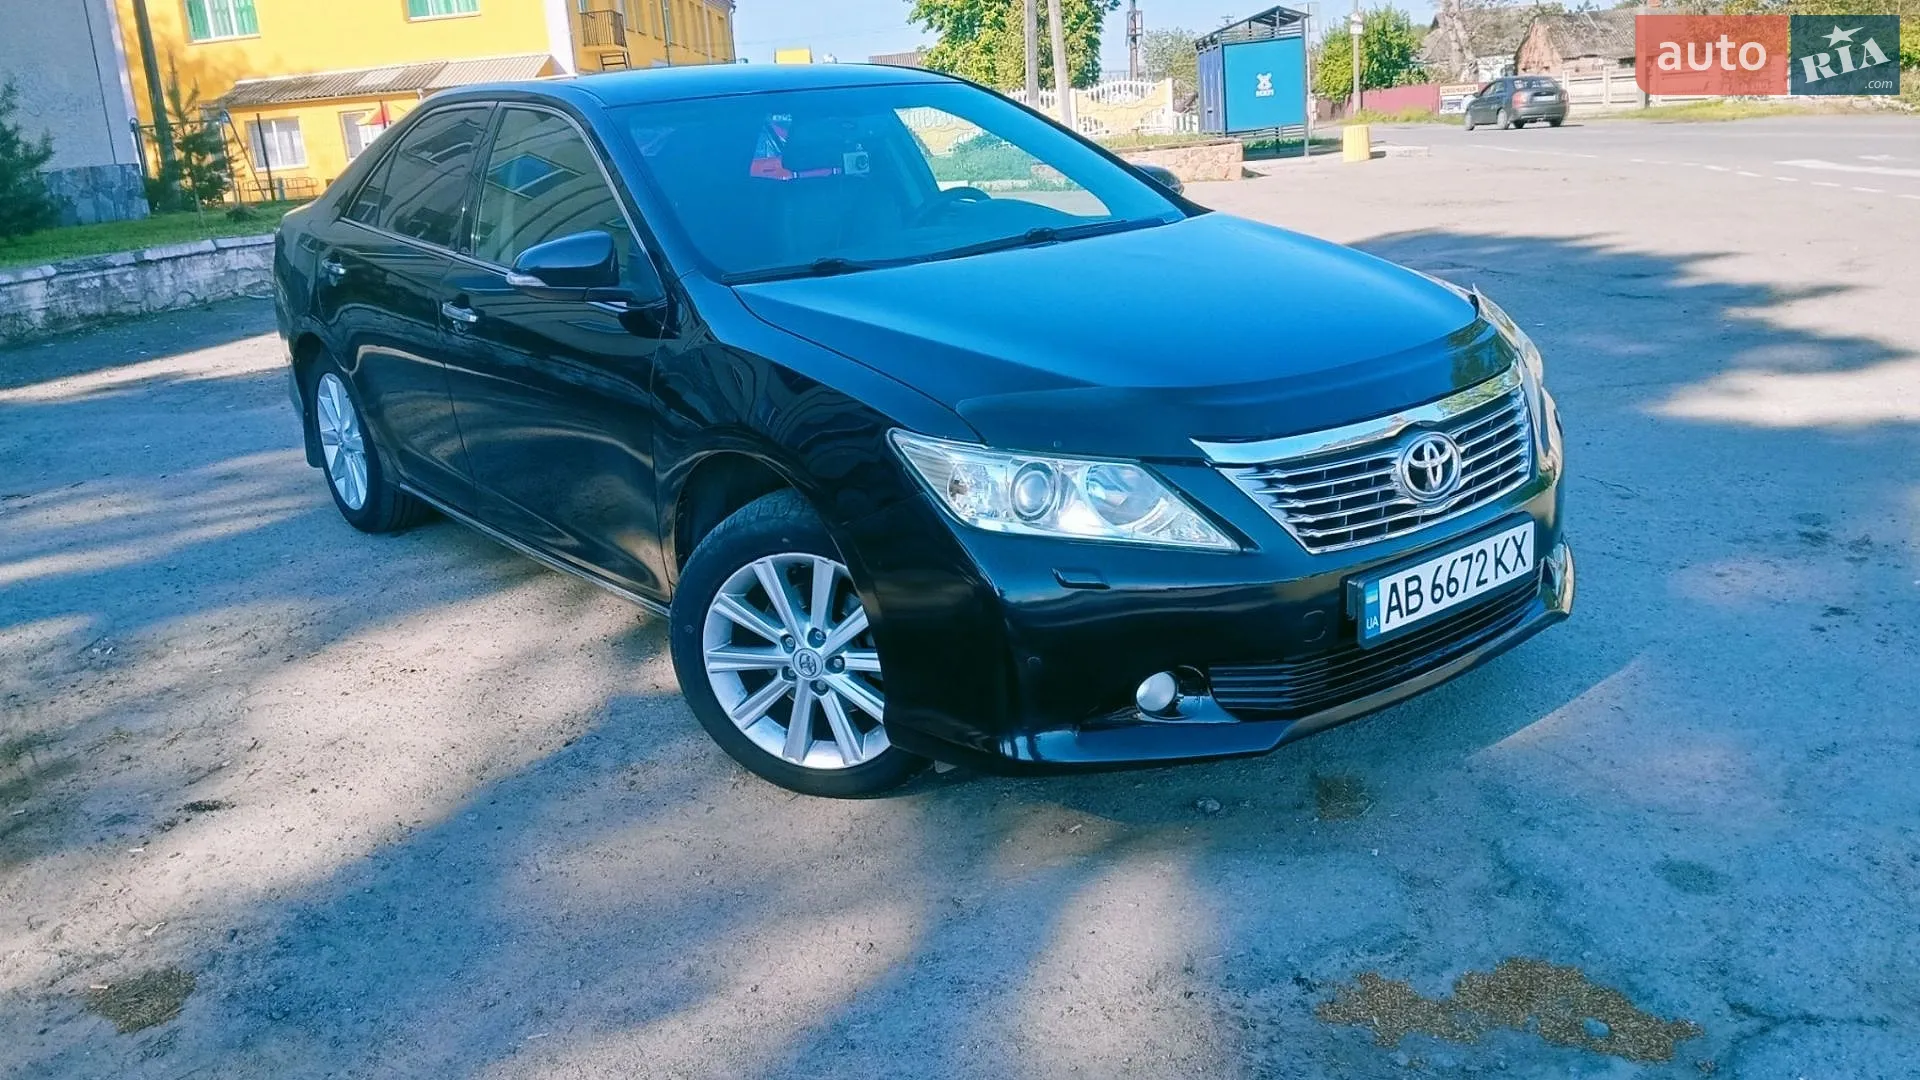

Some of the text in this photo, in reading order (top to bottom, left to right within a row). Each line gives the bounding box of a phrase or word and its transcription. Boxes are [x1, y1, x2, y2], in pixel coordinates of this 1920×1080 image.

[1385, 531, 1528, 624] AB 6672 KX
[1366, 617, 1379, 630] UA
